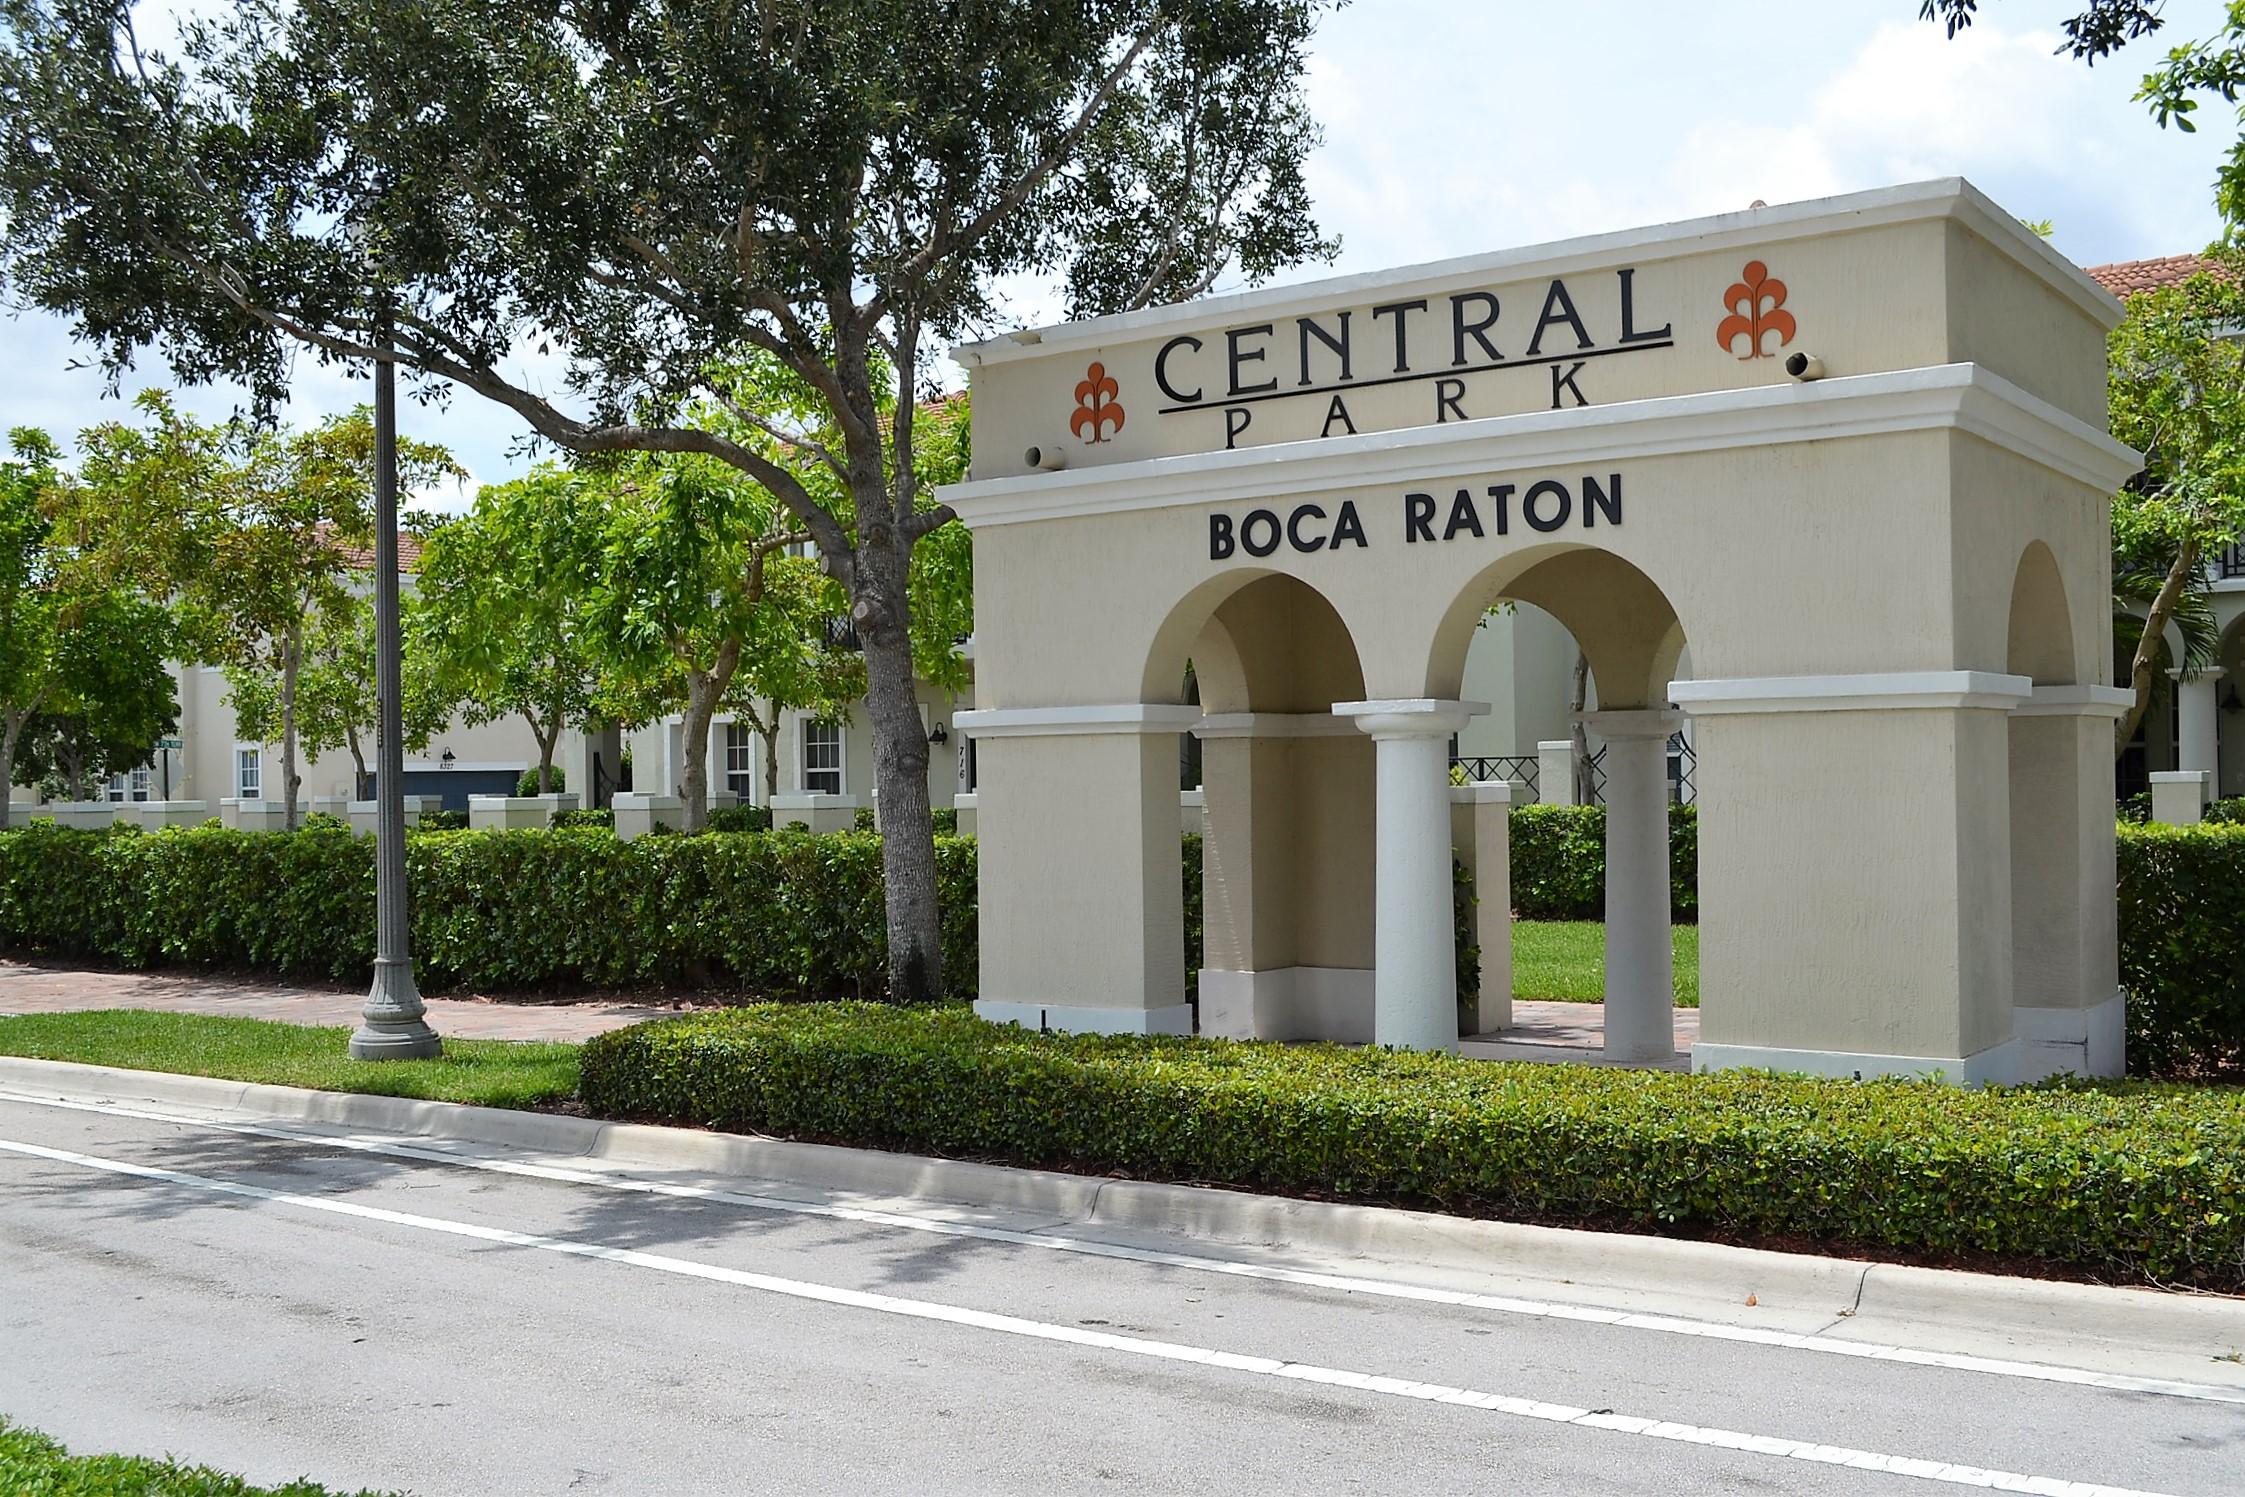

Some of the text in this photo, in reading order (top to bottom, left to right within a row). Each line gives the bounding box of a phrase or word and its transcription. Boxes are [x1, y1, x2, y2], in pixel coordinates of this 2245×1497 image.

[1154, 267, 1672, 404] CENTRAL
[1224, 361, 1589, 450] PARK
[1209, 473, 1622, 561] BOCA RATON
